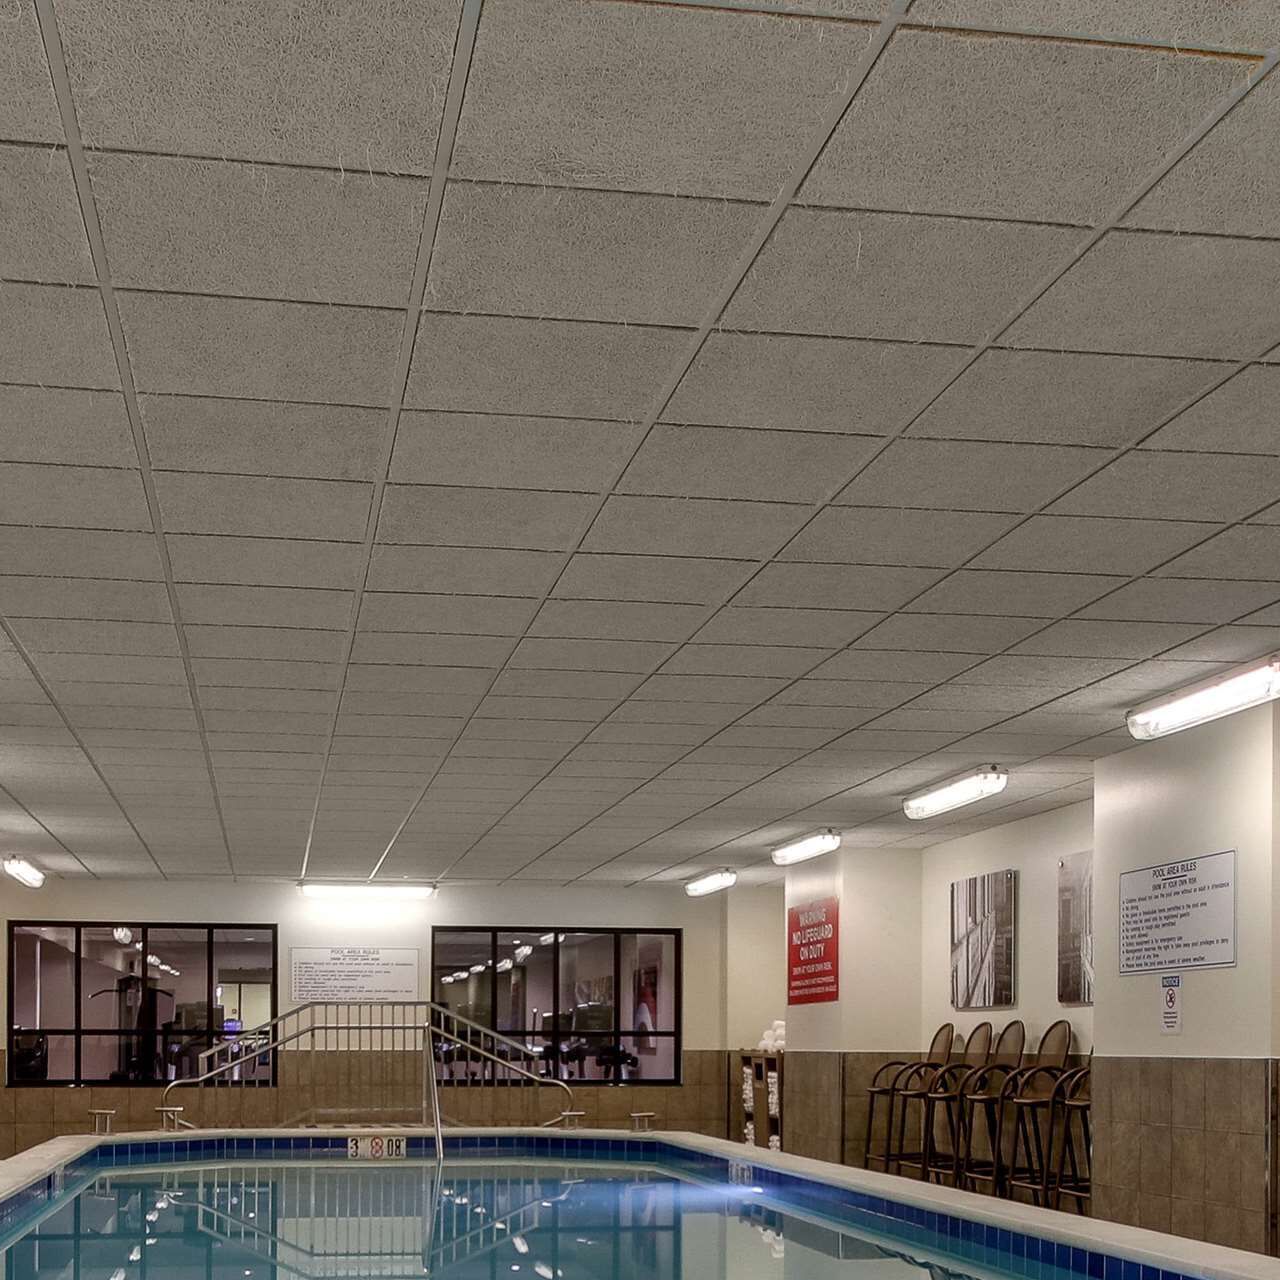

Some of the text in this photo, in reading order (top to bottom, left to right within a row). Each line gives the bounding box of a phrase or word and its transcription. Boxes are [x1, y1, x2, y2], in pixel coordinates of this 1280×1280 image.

[1152, 861, 1197, 879] POOL AREA RULES
[1168, 880, 1178, 888] YOUR
[1178, 878, 1187, 886] OWN
[1188, 876, 1197, 884] RISK
[793, 924, 833, 946] NO LIFEGUARD
[800, 943, 824, 961] ON DUTY
